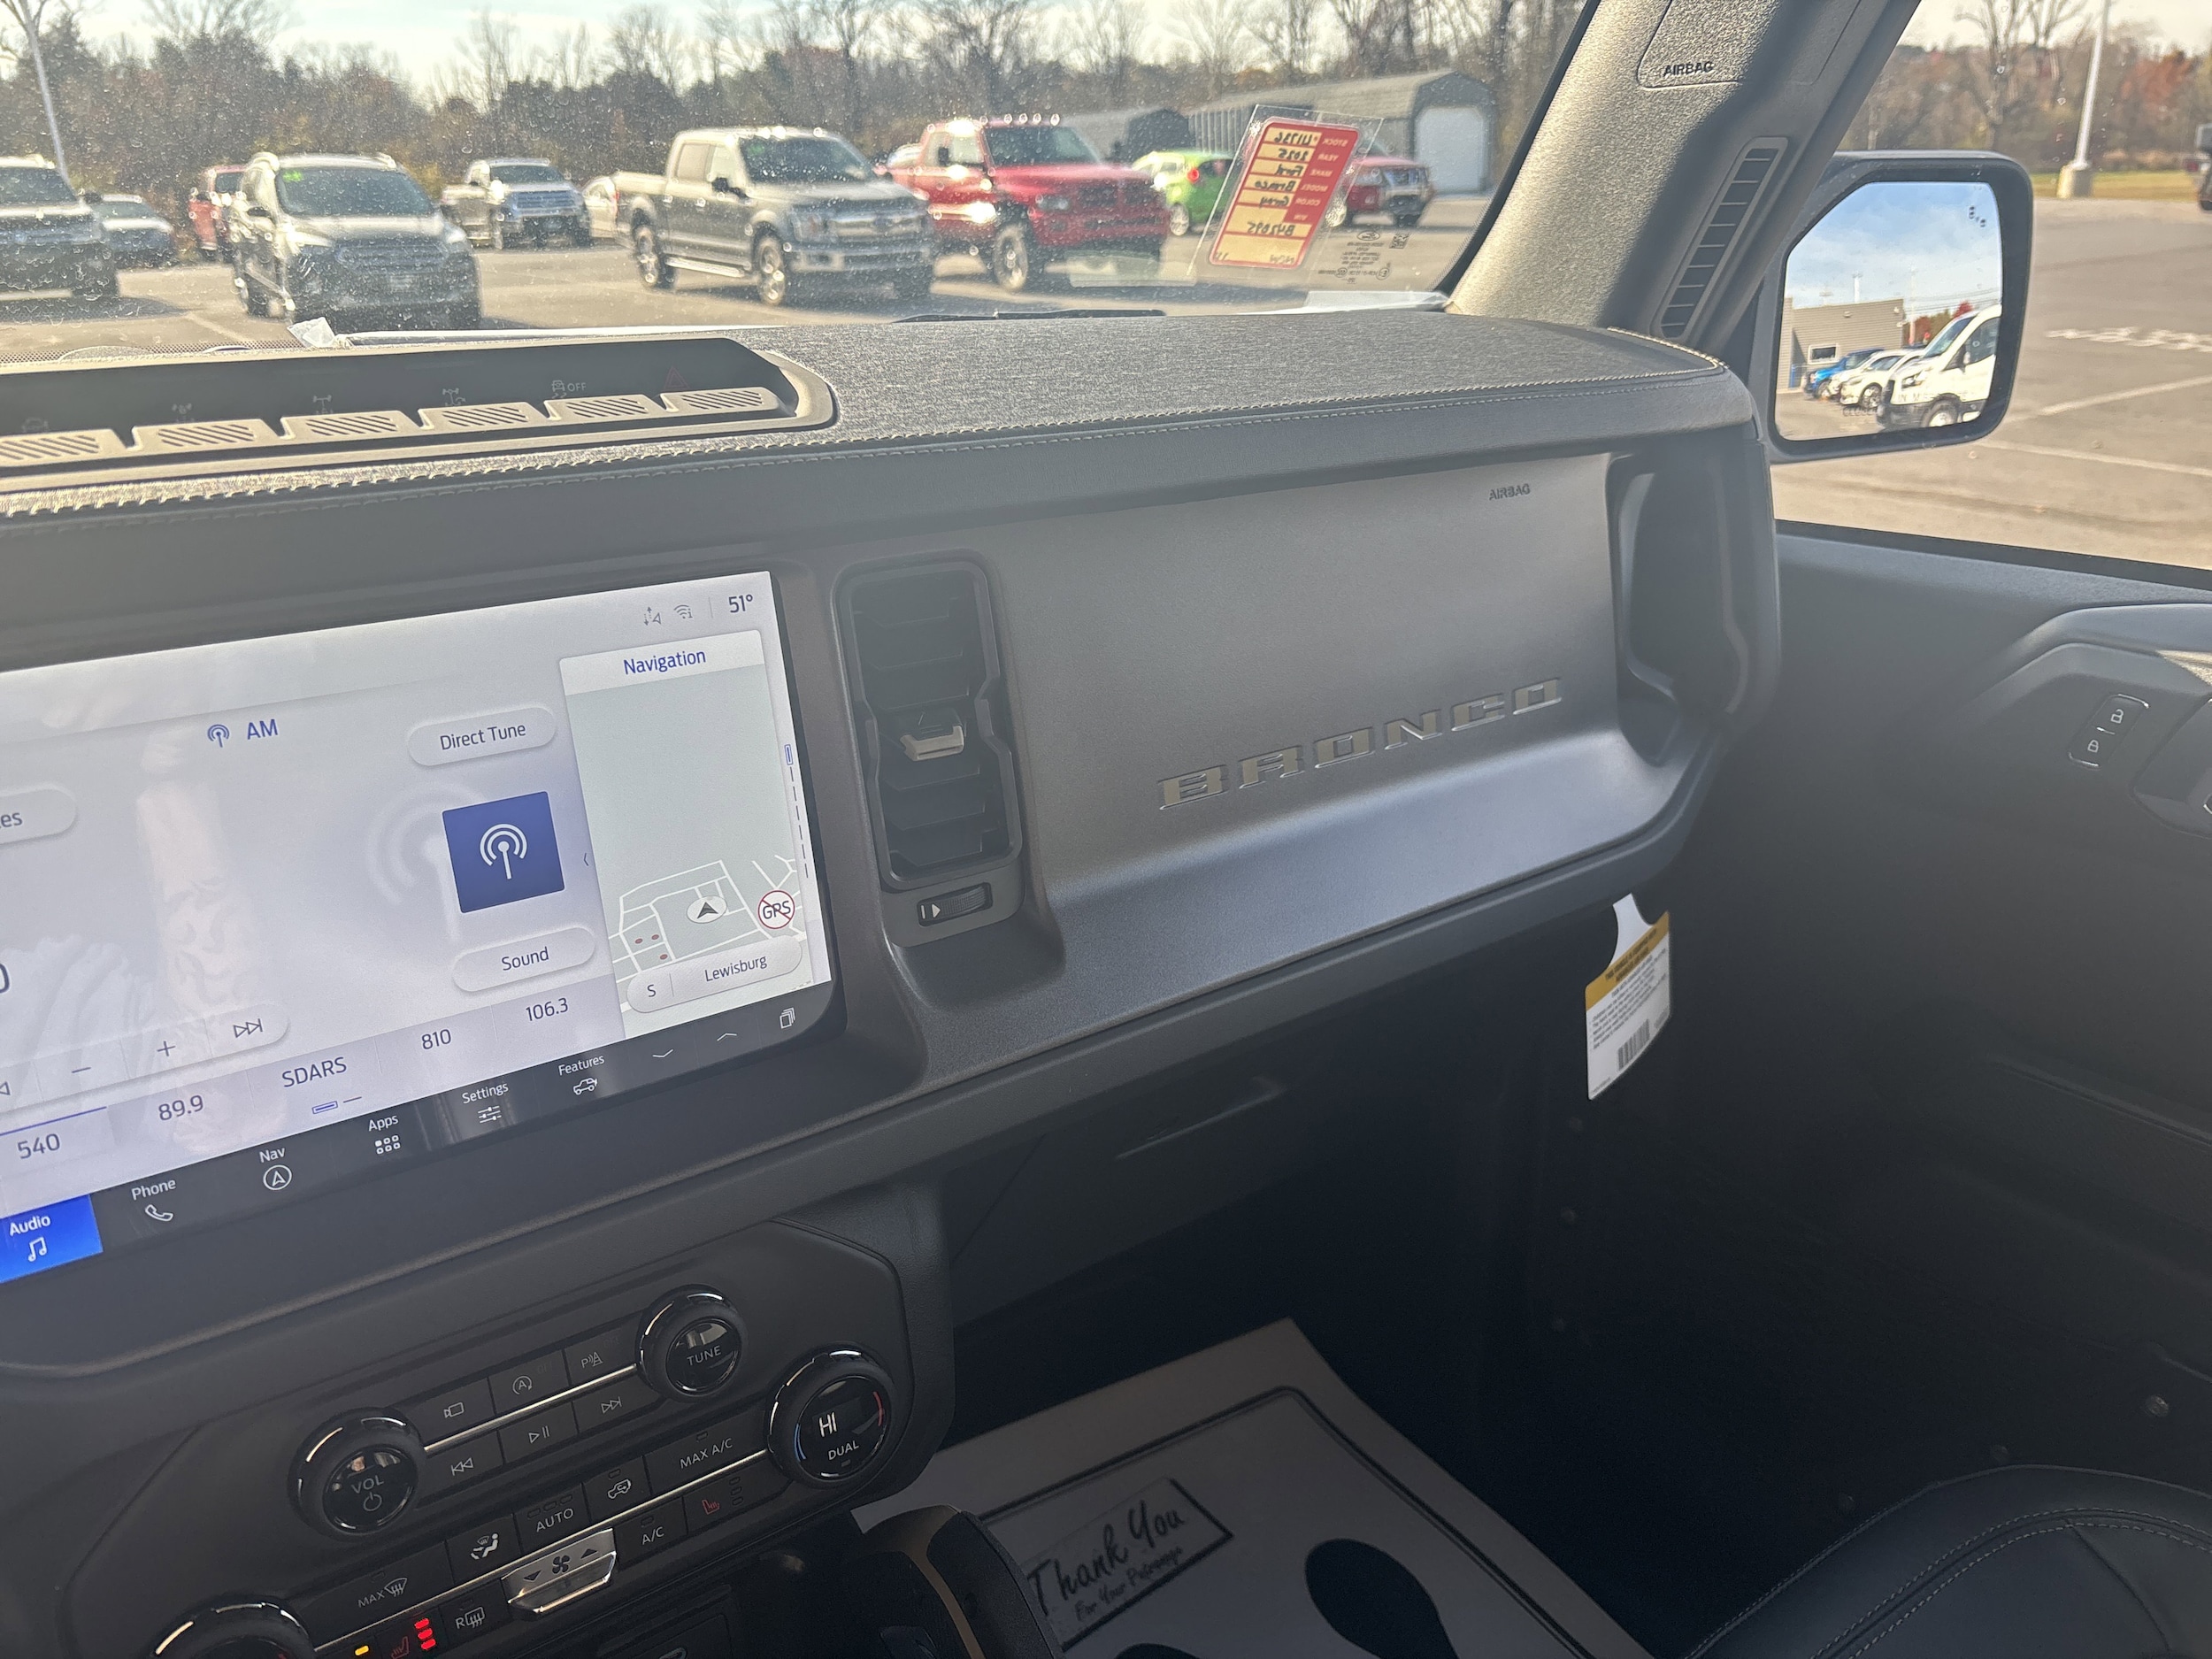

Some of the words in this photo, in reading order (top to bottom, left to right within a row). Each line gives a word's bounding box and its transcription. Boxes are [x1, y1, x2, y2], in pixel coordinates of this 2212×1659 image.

[1663, 61, 1715, 77] AIRBAG
[567, 382, 587, 392] OFF
[1488, 483, 1532, 502] AIRBAG
[728, 594, 754, 614] 51°
[623, 650, 706, 676] Navigation
[247, 718, 279, 741] AM
[440, 728, 484, 751] Direct
[487, 720, 526, 743] Tune
[1157, 677, 1563, 810] BRONCO
[0, 812, 23, 829] es
[763, 900, 791, 919] GPS
[501, 947, 550, 972] Sound
[647, 984, 657, 998] S
[704, 954, 768, 983] Lewisburg
[525, 997, 569, 1023] 106.3
[421, 1028, 452, 1050] 810
[281, 1056, 348, 1088] SDARS
[558, 1054, 605, 1077] Features
[461, 1081, 509, 1105] Settings
[157, 1095, 204, 1121] 89.9
[368, 1113, 399, 1133] Apps
[17, 1133, 62, 1160] 540
[259, 1146, 286, 1164] Nav
[132, 1179, 177, 1201] Phone
[8, 1213, 51, 1237] Audio
[687, 1346, 723, 1366] TUNE
[818, 1413, 838, 1437] HI
[680, 1448, 708, 1470] MAX
[711, 1437, 733, 1456] A/C
[827, 1441, 860, 1462] DUAL
[351, 1474, 385, 1494] VOL
[535, 1508, 574, 1532] AUTO
[641, 1526, 665, 1546] A/C
[1026, 1523, 1129, 1617] Thank
[1126, 1500, 1186, 1548] You
[357, 1589, 386, 1609] MAX
